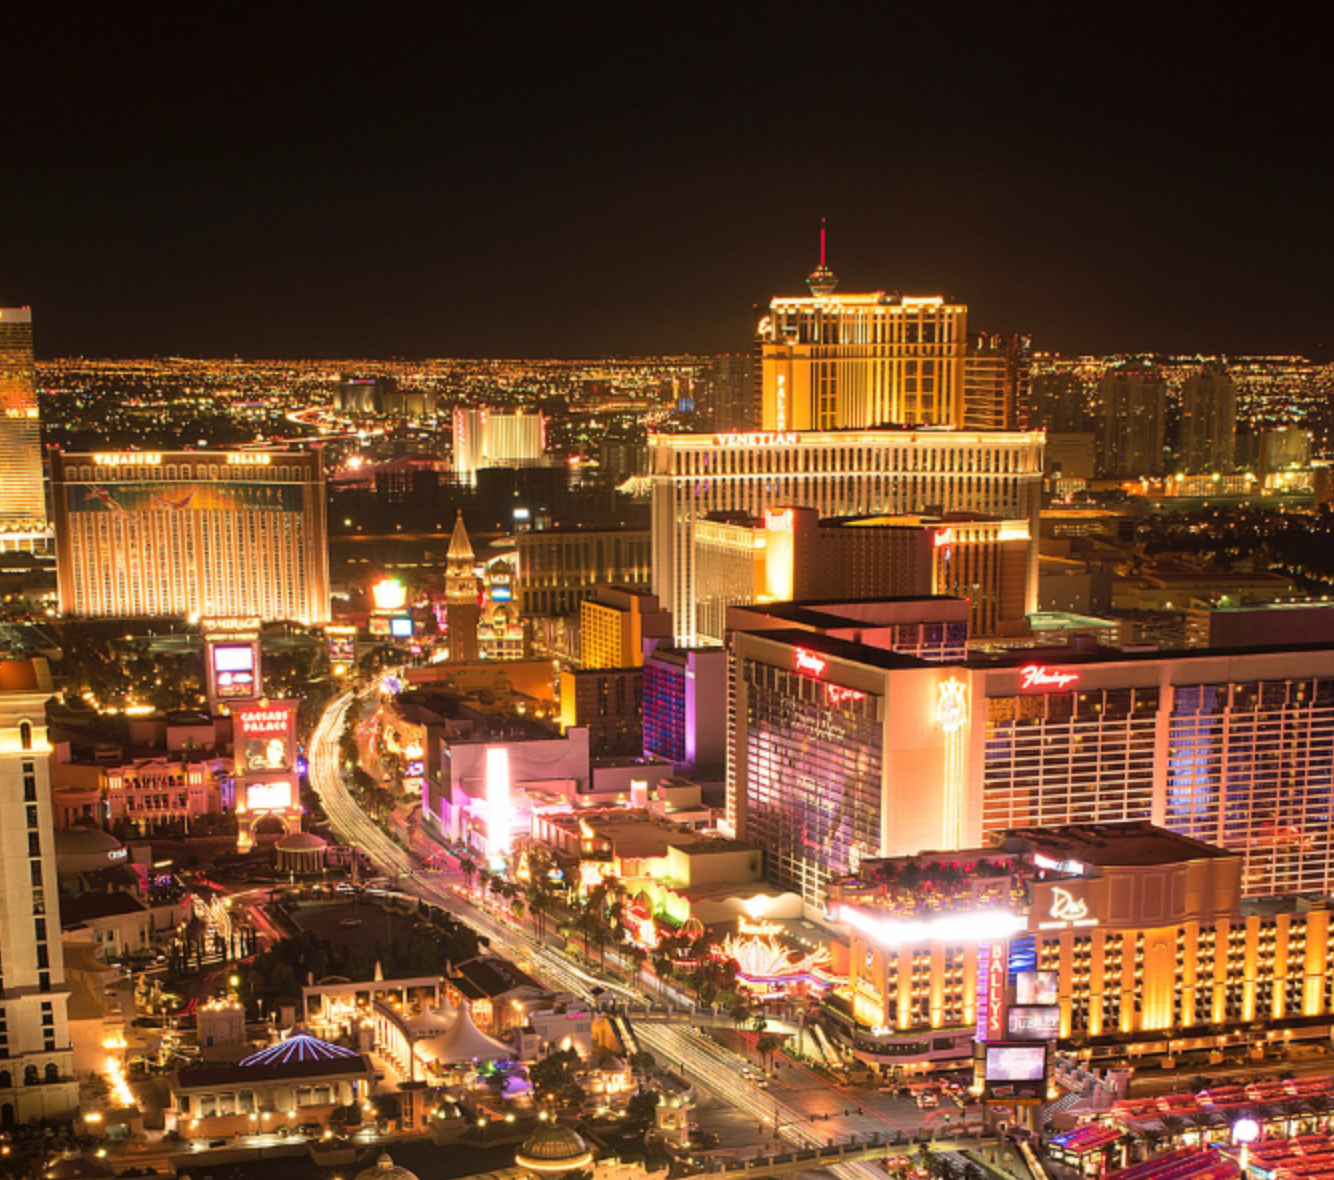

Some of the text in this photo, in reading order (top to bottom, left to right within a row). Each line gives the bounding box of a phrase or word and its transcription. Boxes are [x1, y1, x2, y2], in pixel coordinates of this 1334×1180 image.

[717, 432, 797, 446] VENETIAN
[94, 453, 271, 464] TREASURE ISLAND
[1020, 665, 1079, 689] Flamingo
[241, 711, 287, 721] CAESARS
[243, 721, 286, 731] PALACE
